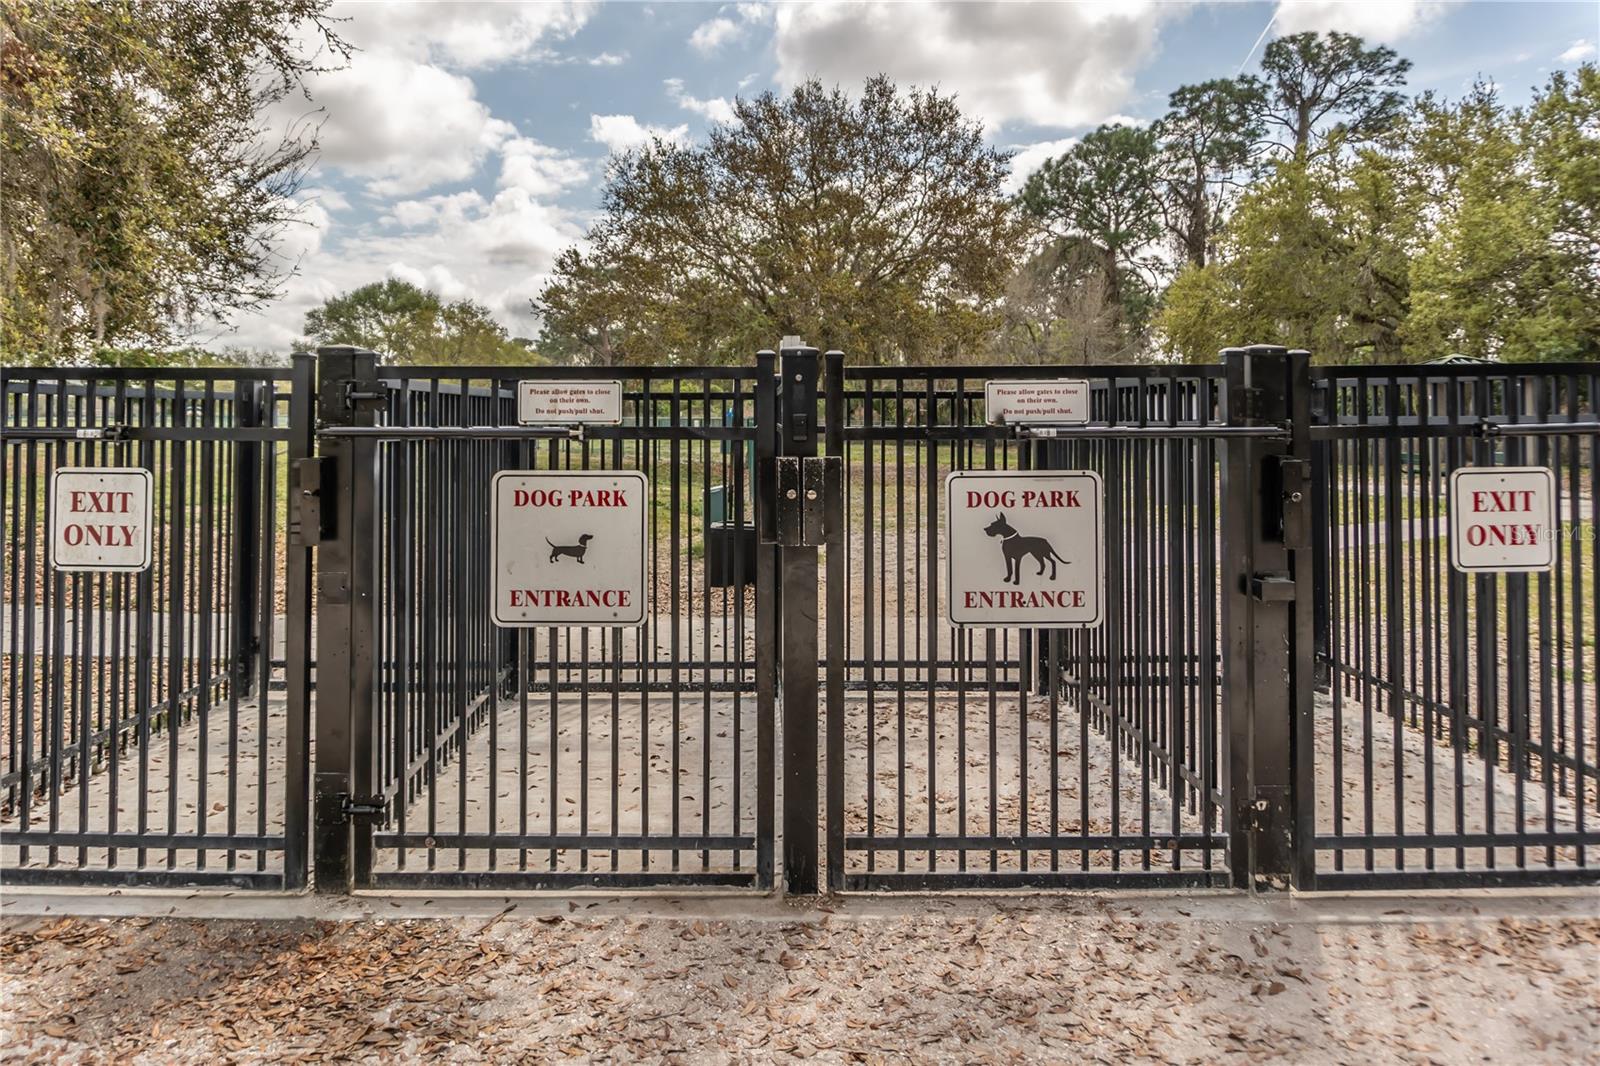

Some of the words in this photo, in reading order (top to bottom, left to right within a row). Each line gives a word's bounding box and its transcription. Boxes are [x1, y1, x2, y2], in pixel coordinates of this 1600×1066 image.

[558, 408, 588, 416] push/pull
[1025, 408, 1056, 416] push/pull
[70, 491, 134, 513] EXIT
[513, 489, 563, 507] DOG
[569, 489, 628, 507] PARK
[966, 490, 1016, 508] DOG
[1023, 490, 1081, 508] PARK
[1472, 490, 1536, 513] EXIT
[63, 523, 137, 547] ONLY
[1466, 524, 1541, 547] ONLY
[509, 589, 631, 607] ENTRANCE
[963, 591, 1085, 608] ENTRANCE
